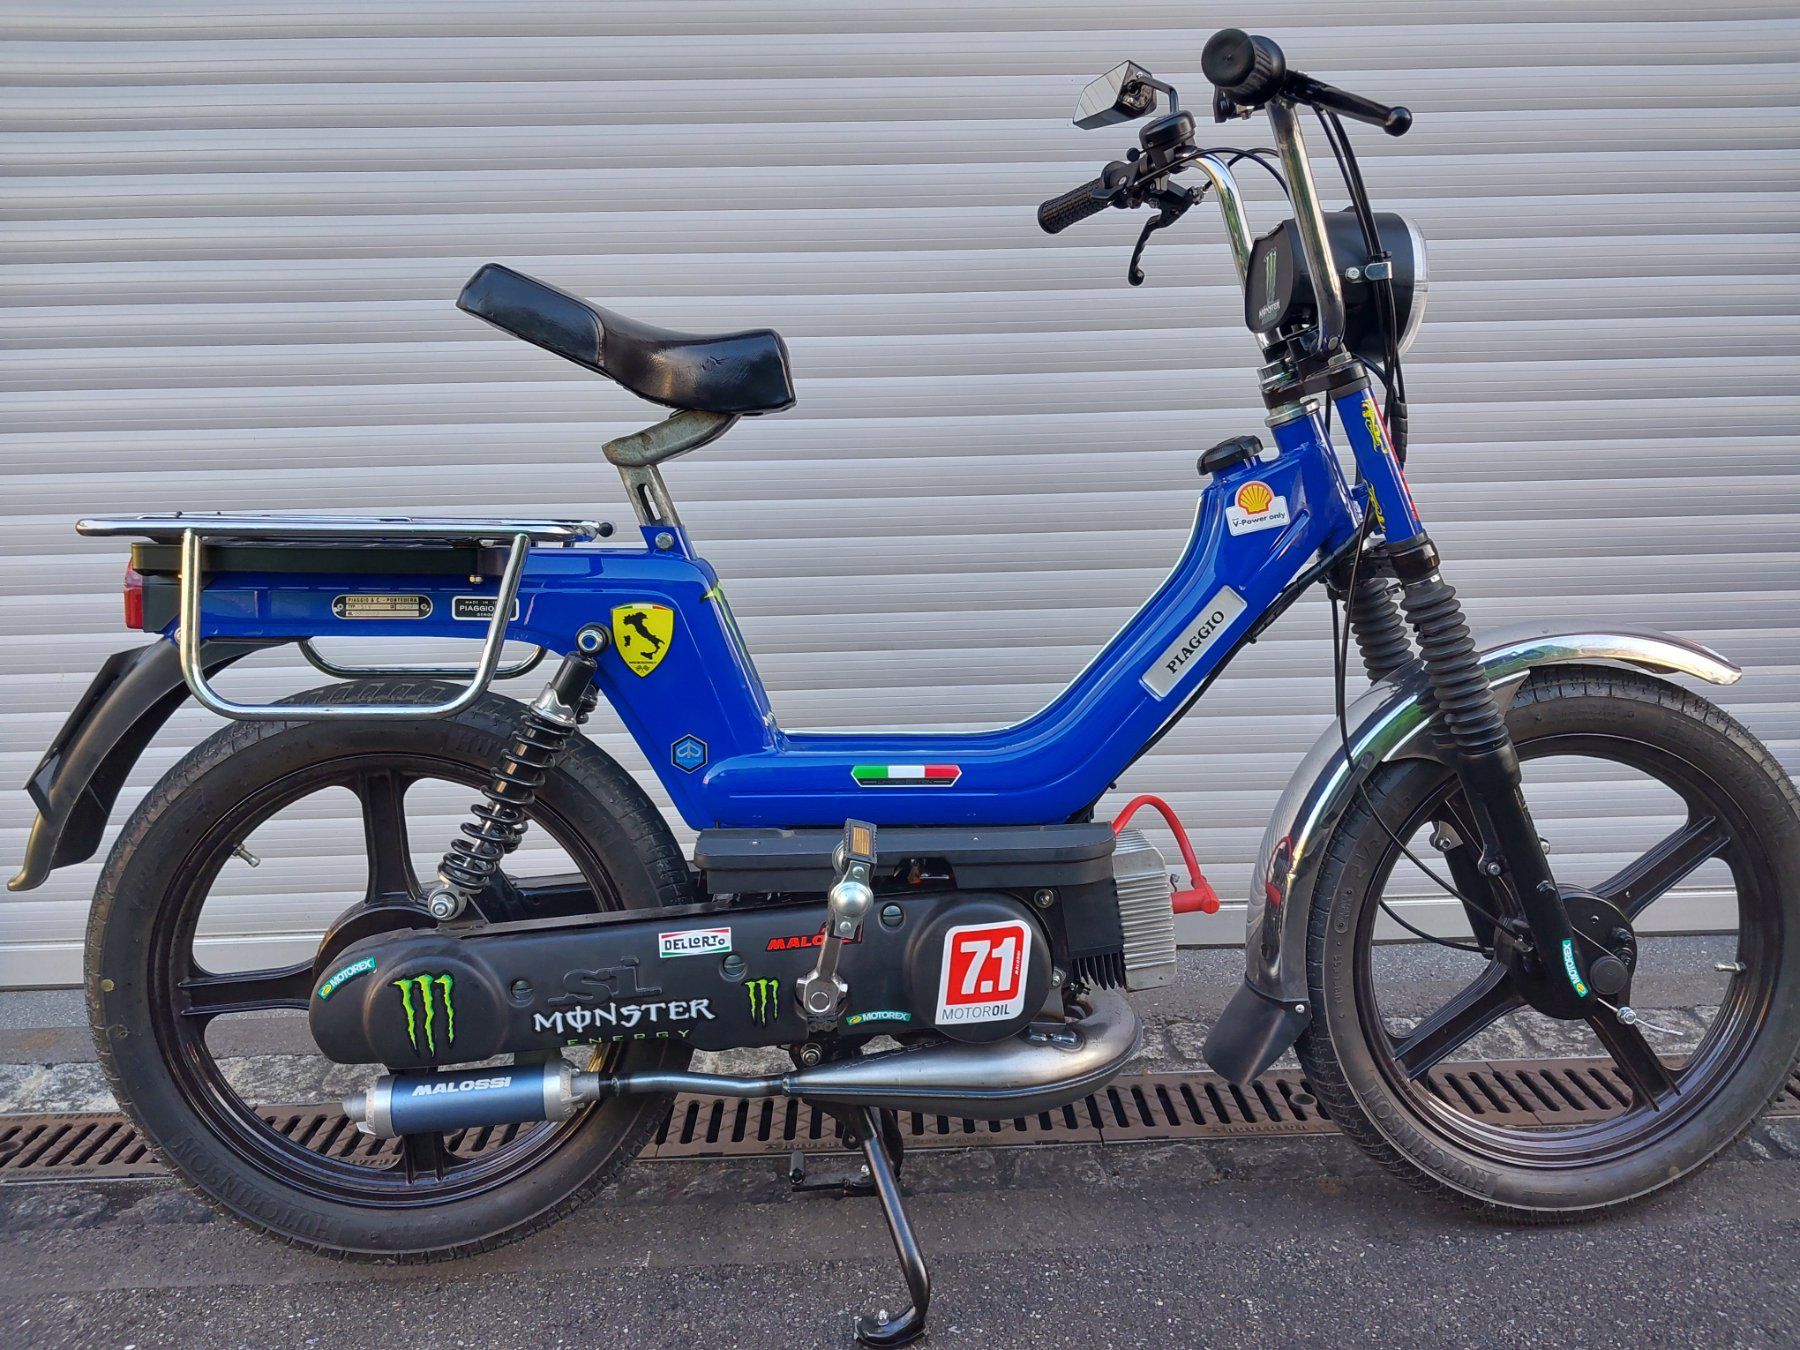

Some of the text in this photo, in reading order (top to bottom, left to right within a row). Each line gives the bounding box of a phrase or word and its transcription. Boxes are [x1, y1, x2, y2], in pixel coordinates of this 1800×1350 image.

[1232, 512, 1286, 527] V-Power only
[1165, 610, 1225, 674] PIAGGIO
[664, 935, 726, 951] DELLORTO
[329, 960, 373, 988] MOTOREX
[960, 936, 1016, 995] 7.1
[1562, 943, 1580, 984] MOTOREX
[533, 998, 716, 1034] MONSTER
[862, 1010, 908, 1021] MOTOREX
[566, 1029, 690, 1046] ENERGY
[411, 1076, 512, 1097] MALOSSI
